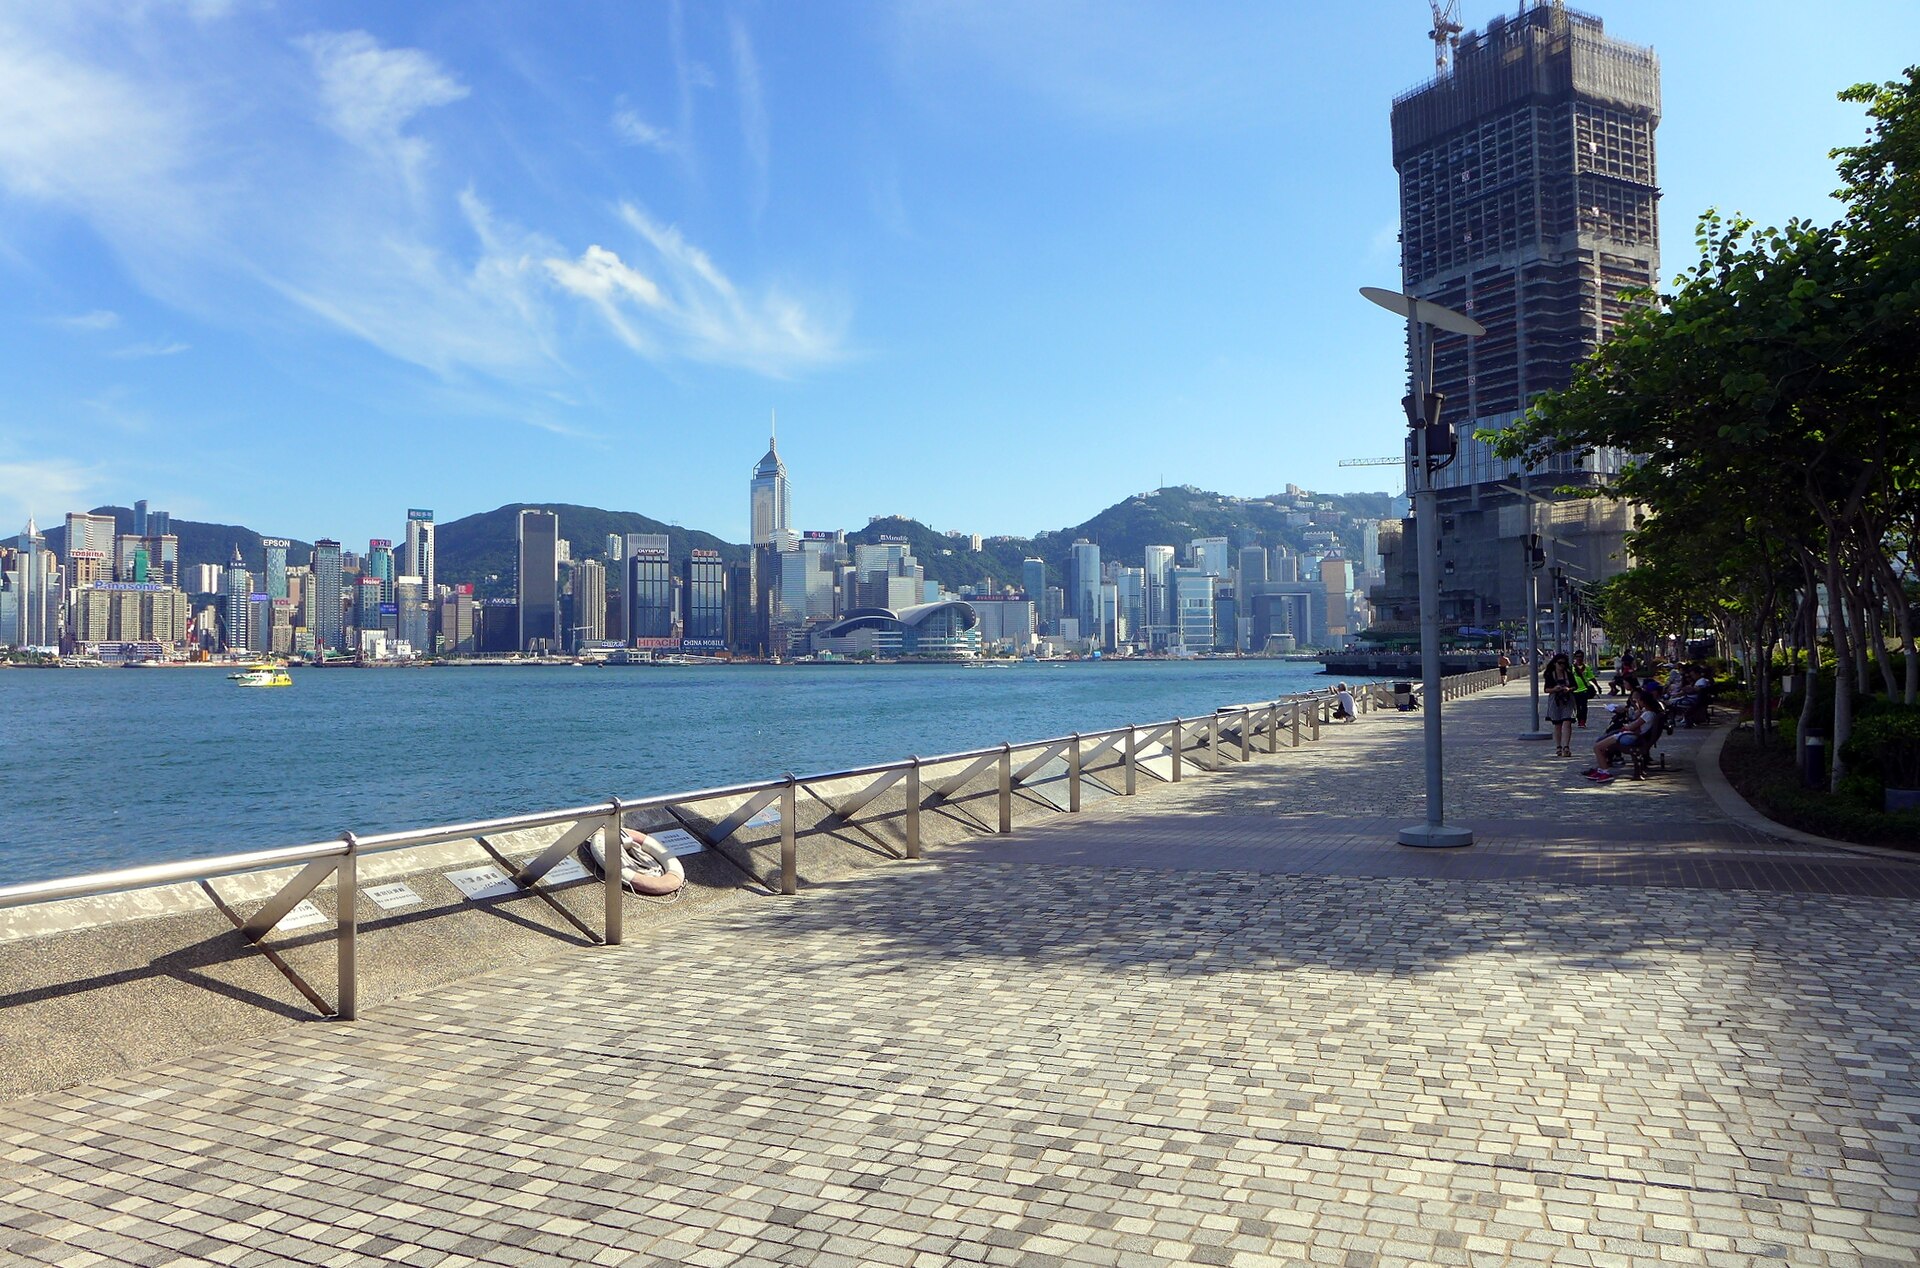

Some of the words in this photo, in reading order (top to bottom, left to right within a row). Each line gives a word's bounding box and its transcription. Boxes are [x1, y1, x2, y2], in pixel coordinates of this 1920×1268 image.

[263, 539, 290, 547] EPSON
[71, 550, 105, 558] TOSHIBA
[95, 580, 162, 591] Panasonic
[638, 639, 680, 647] HITACHI
[683, 639, 702, 647] CHINA
[703, 639, 725, 647] MOBILE
